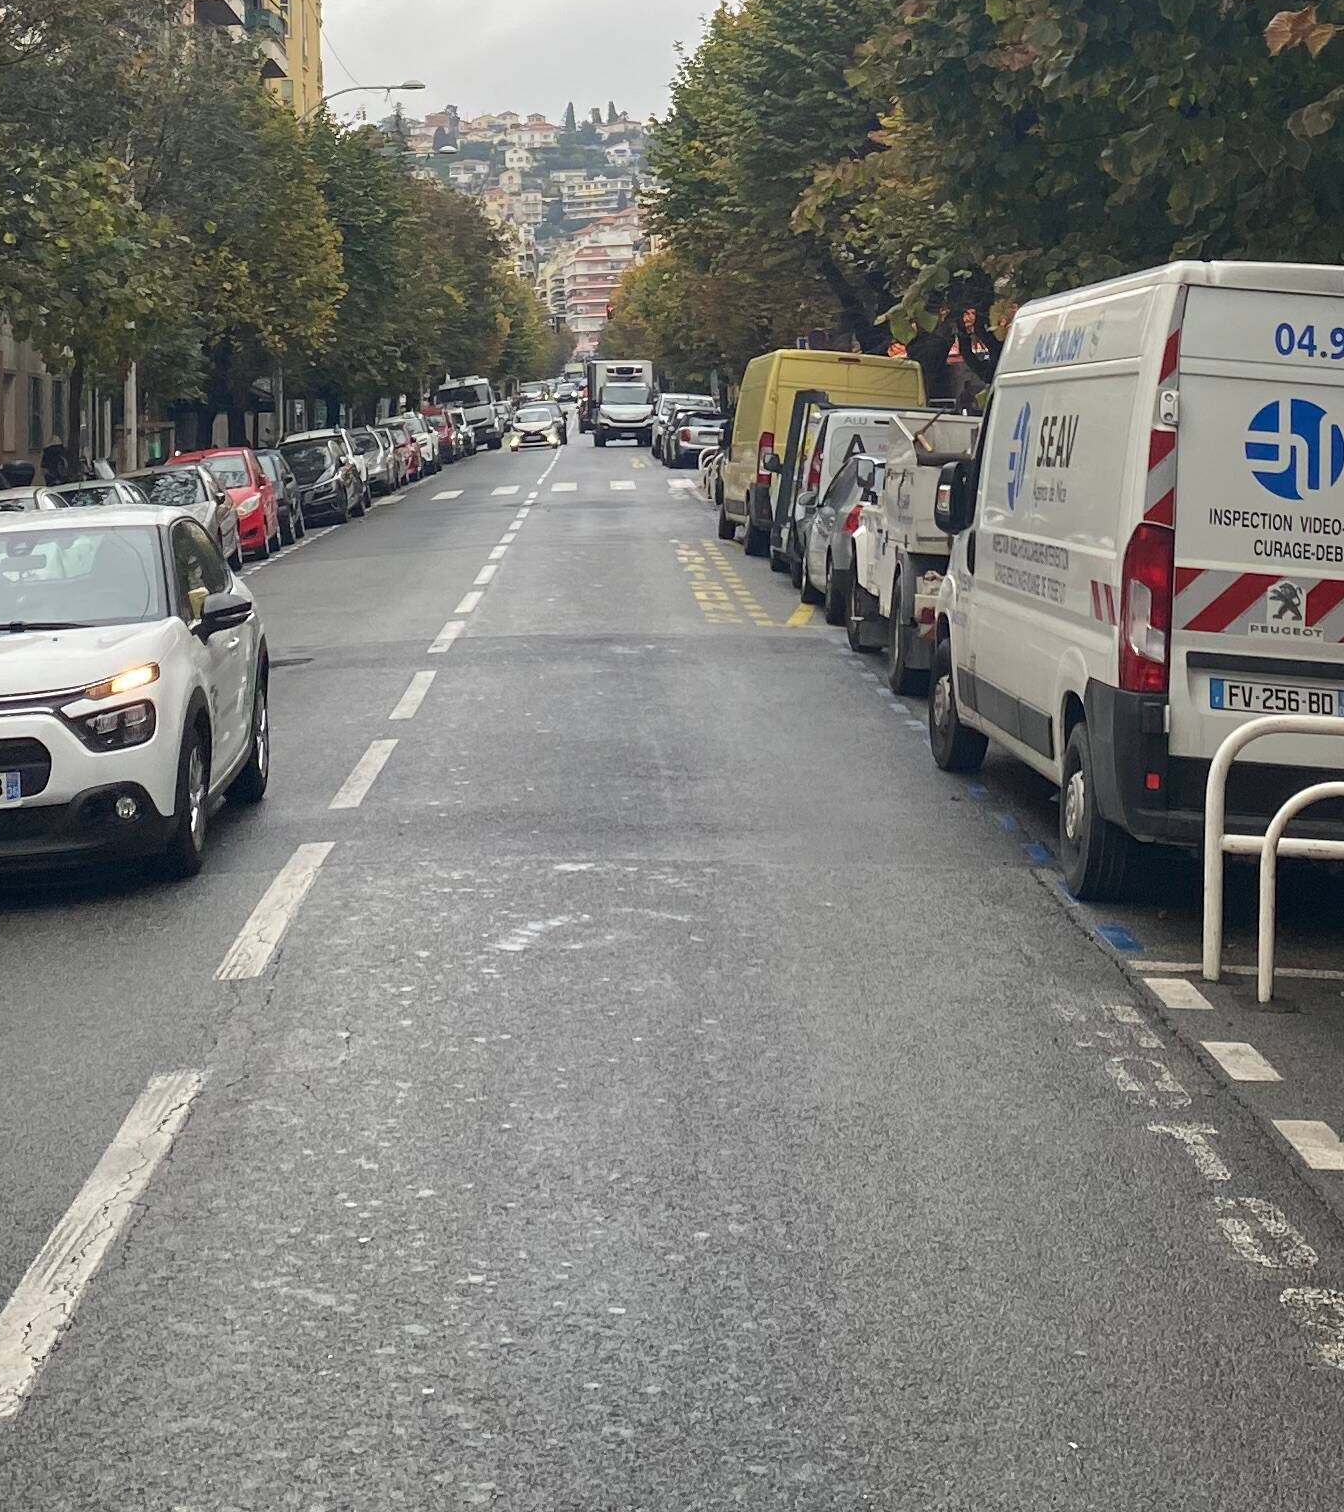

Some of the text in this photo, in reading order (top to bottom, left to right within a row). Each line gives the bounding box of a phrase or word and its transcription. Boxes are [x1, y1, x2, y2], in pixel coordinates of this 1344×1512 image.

[1208, 507, 1293, 532] INSPECTION
[1250, 624, 1324, 638] PEUGEOT
[1228, 685, 1334, 715] FV-256-BD
